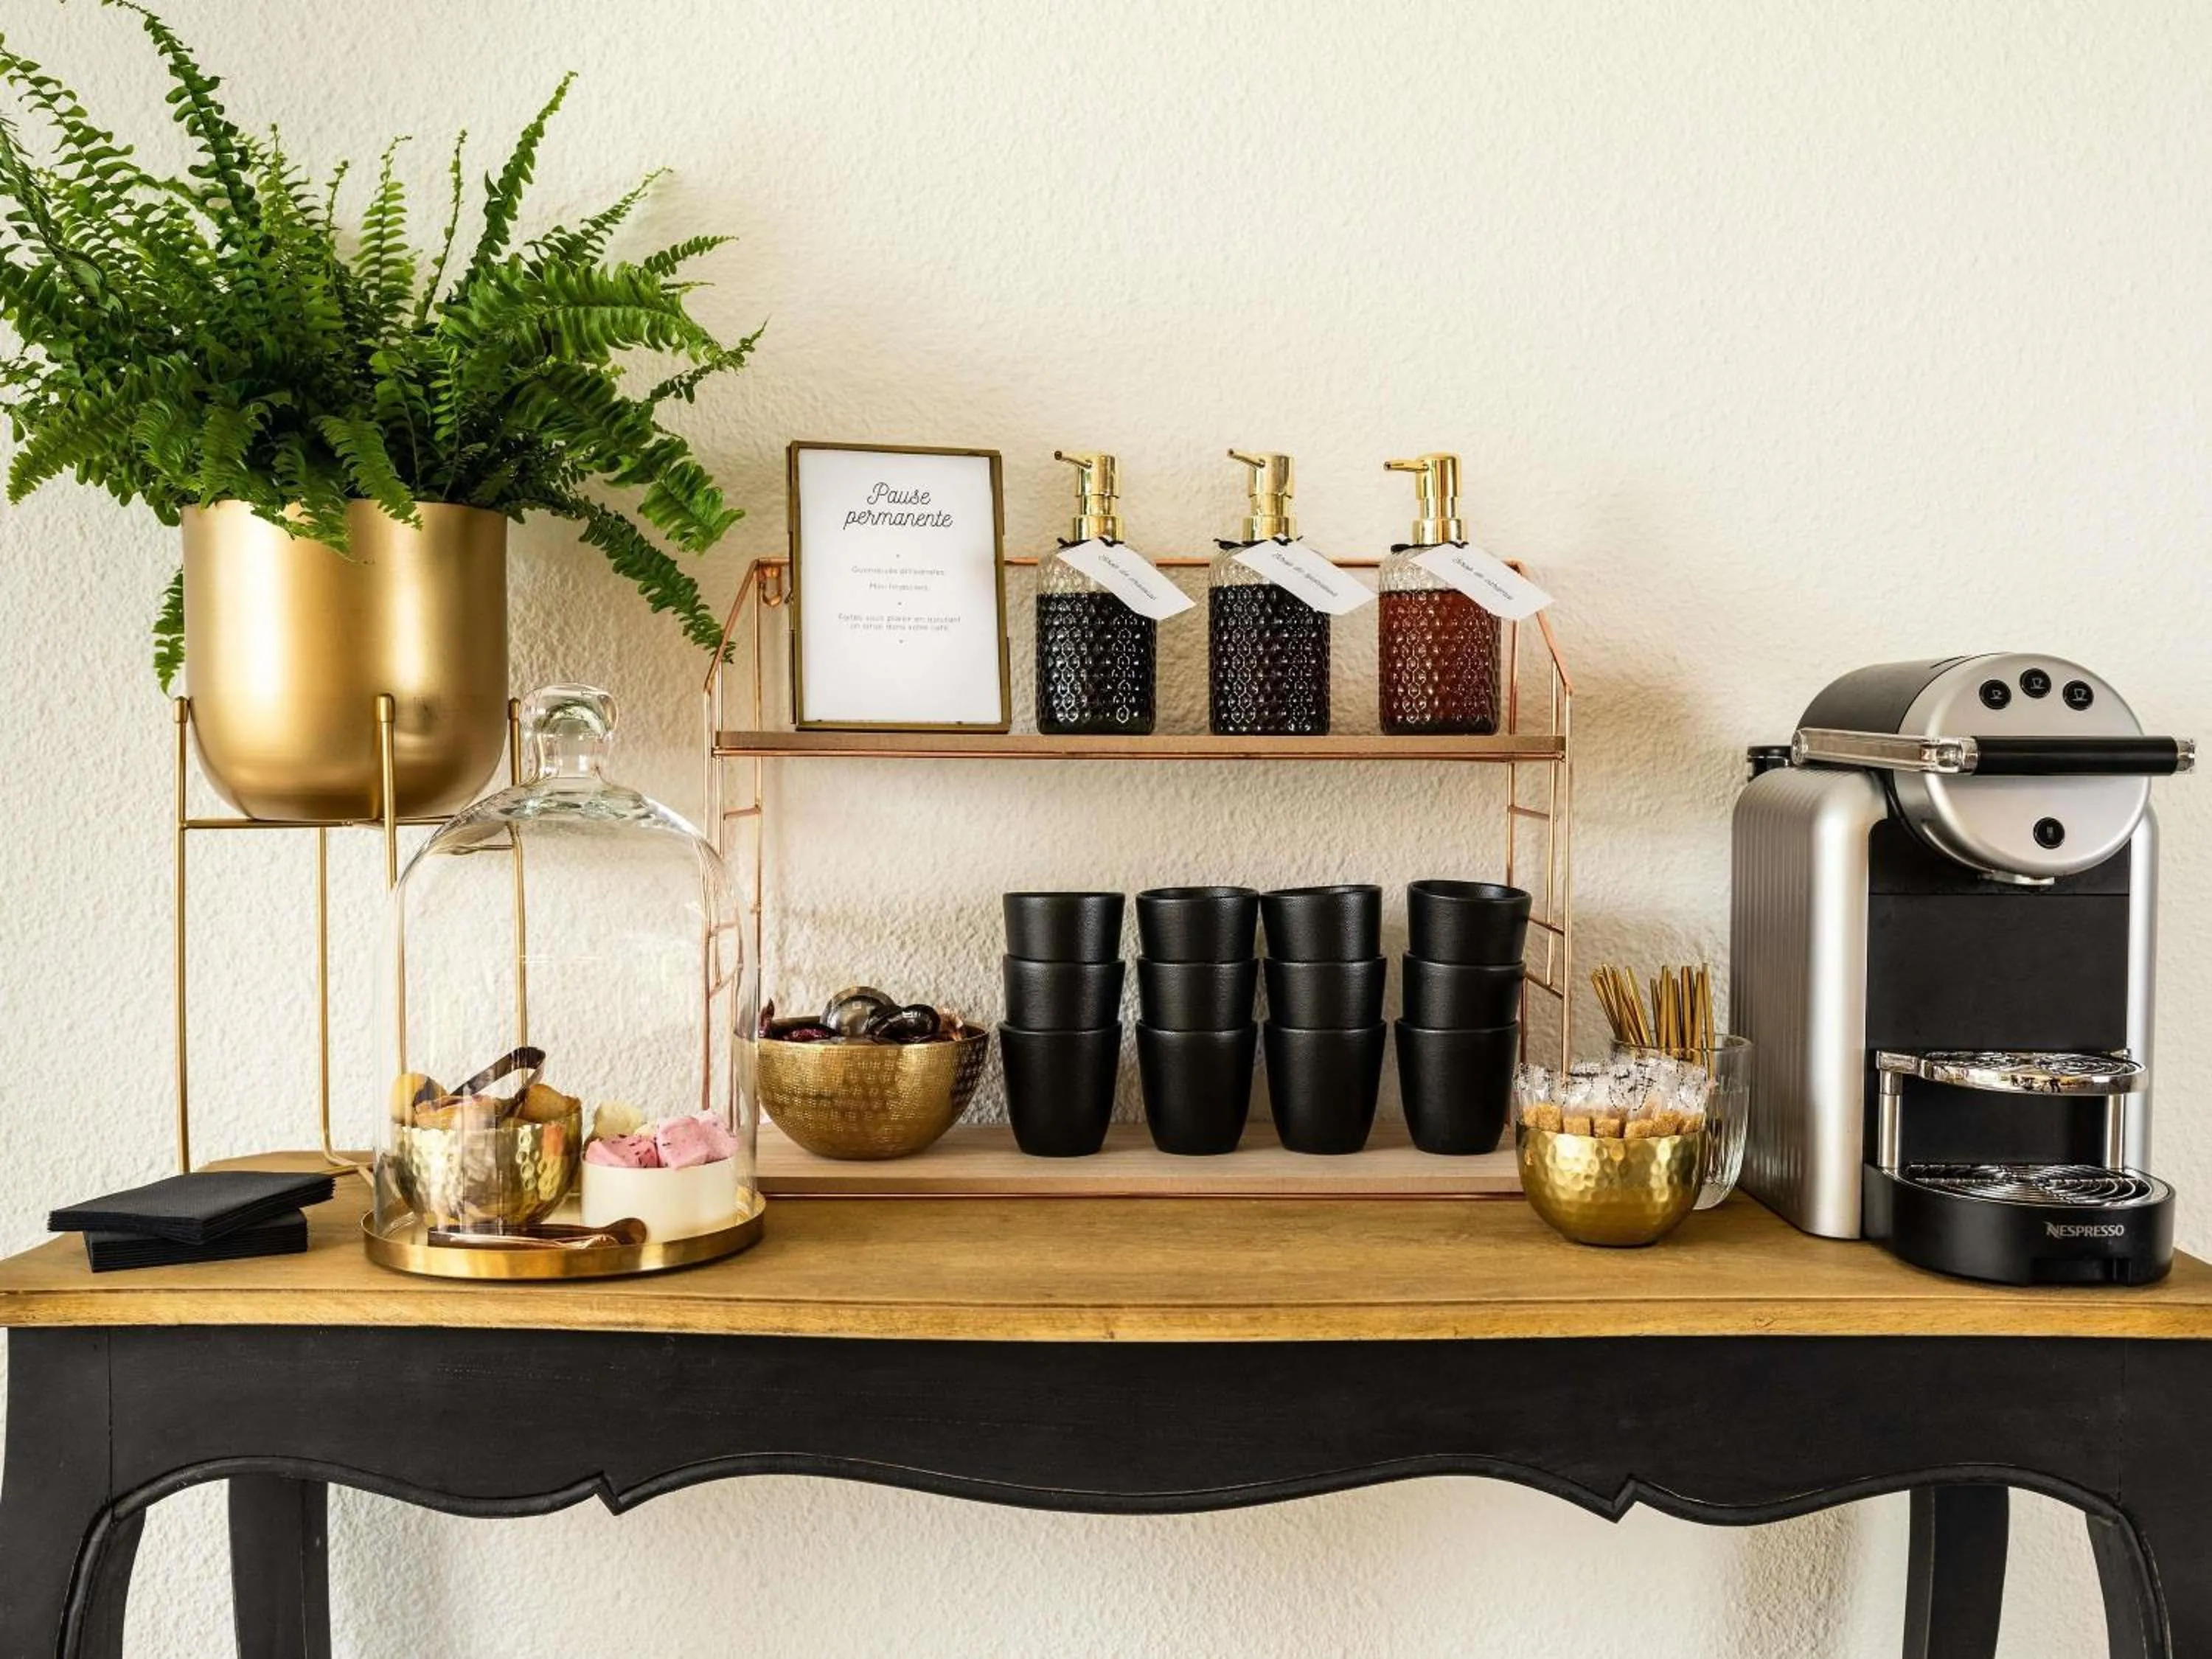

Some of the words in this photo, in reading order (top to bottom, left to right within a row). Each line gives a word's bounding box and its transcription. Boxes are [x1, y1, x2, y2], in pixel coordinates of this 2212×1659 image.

[866, 481, 931, 505] Pause
[842, 509, 953, 530] permanente
[2043, 1220, 2125, 1239] NESPRESSO
